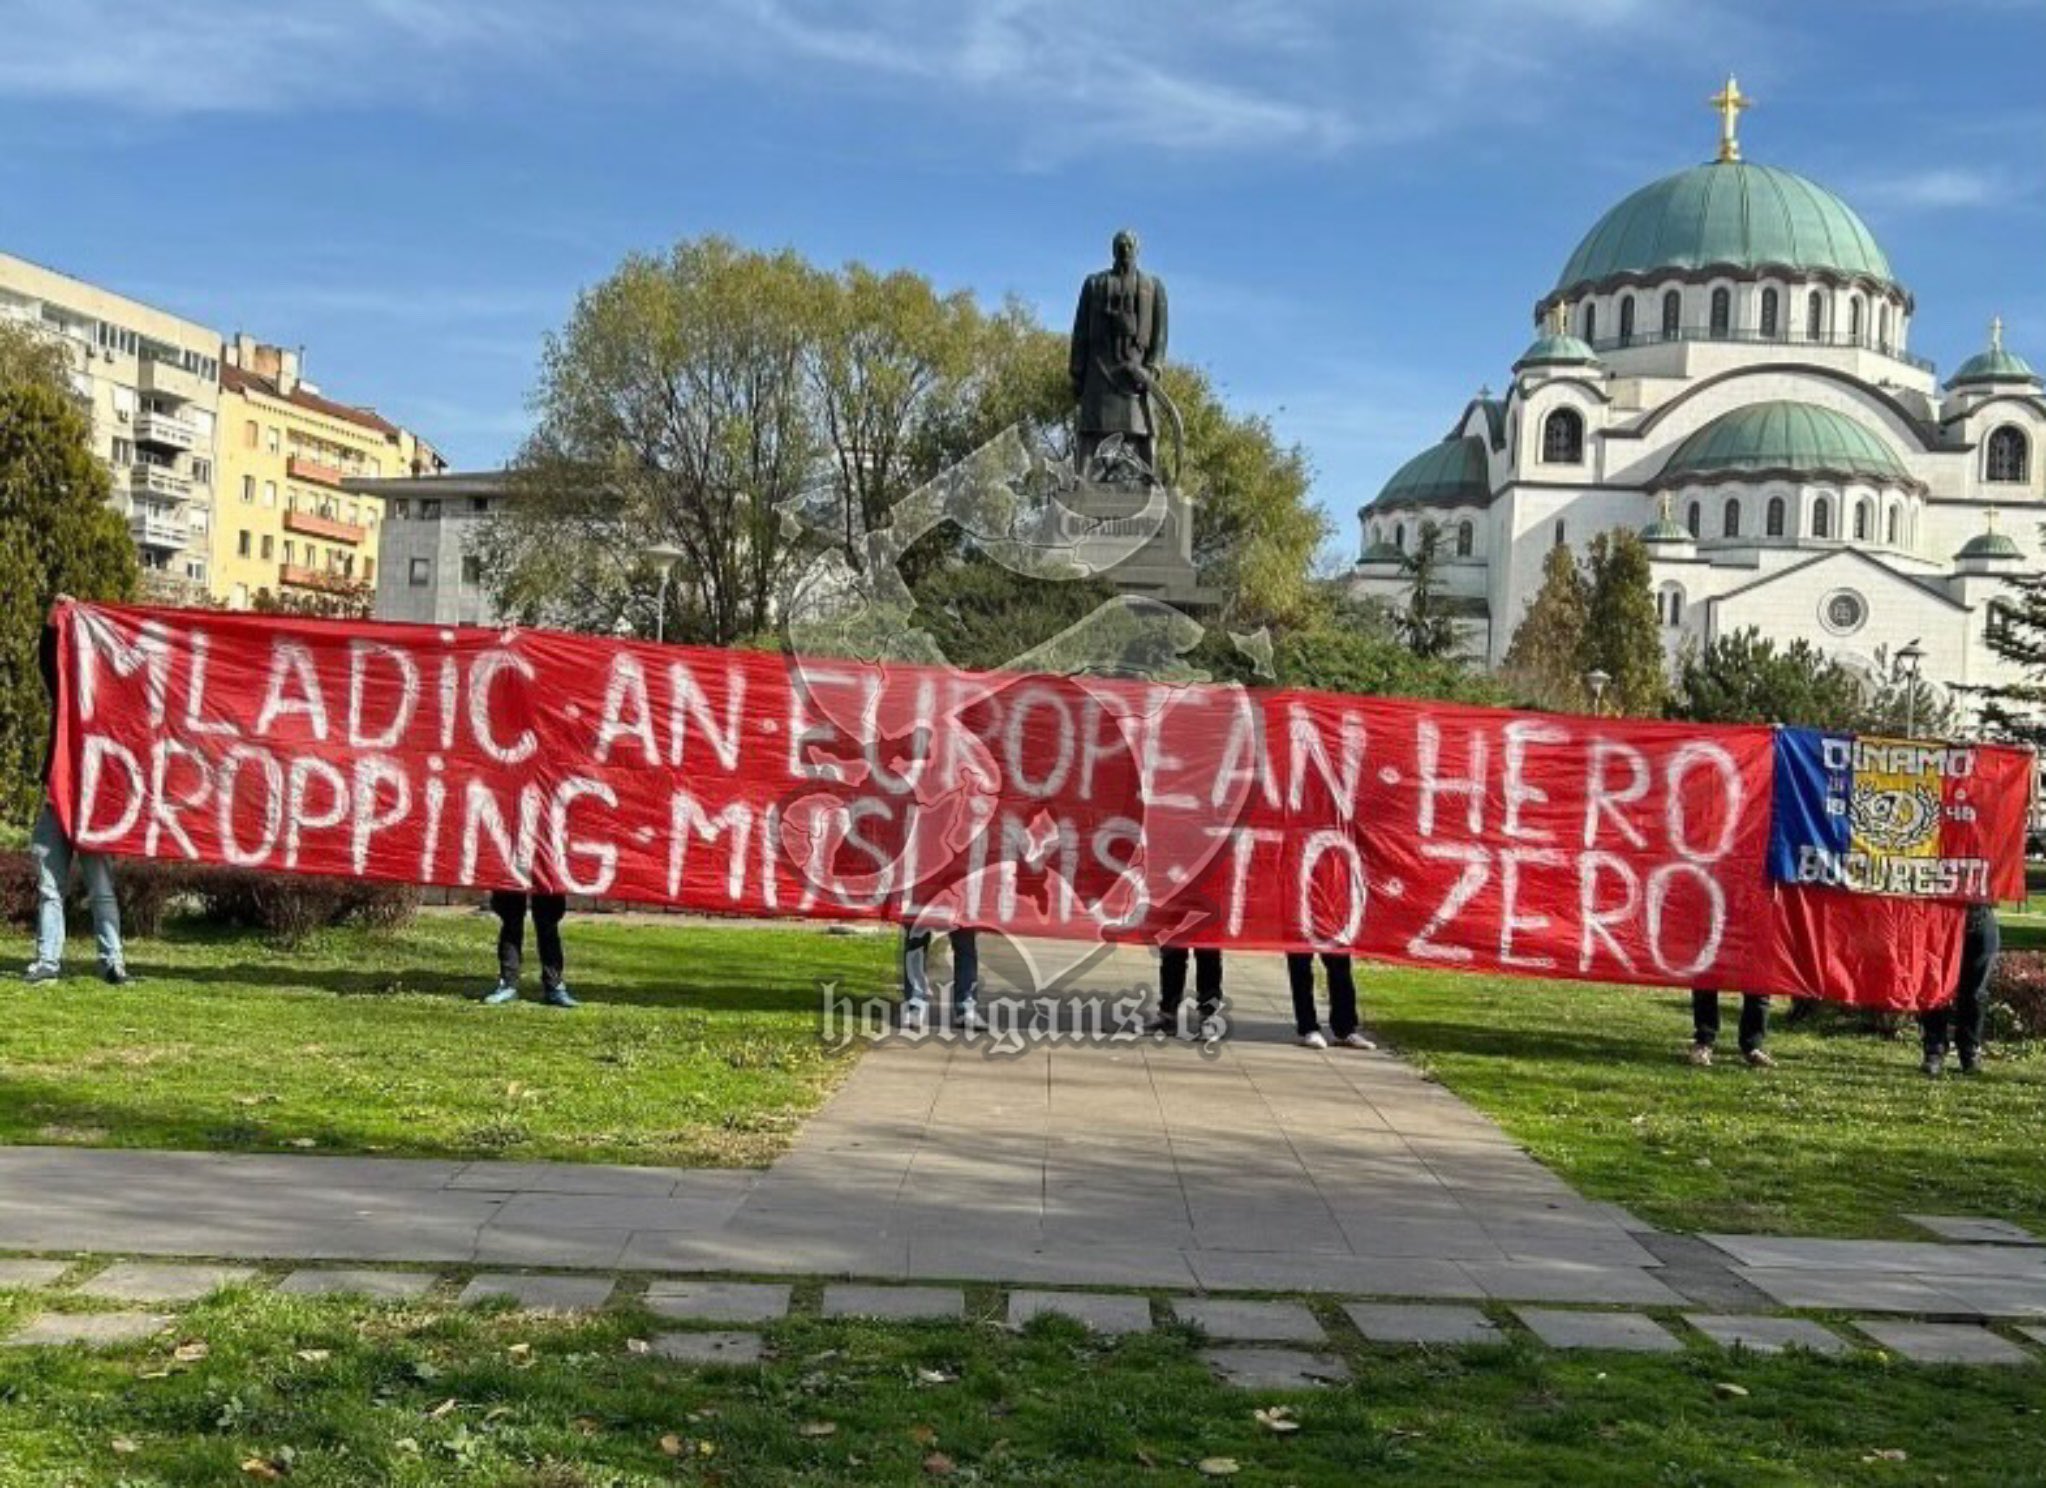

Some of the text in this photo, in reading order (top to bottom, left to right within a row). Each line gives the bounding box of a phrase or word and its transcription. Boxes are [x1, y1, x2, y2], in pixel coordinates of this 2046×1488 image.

[594, 651, 747, 770] AN
[788, 667, 1367, 821] EUROPEAN
[1416, 713, 1743, 862] HERO
[1821, 738, 1976, 777] DINAMO
[1204, 826, 1367, 950] TO
[1408, 841, 1726, 977] ZERO
[1798, 845, 1989, 897] BUCURESTI
